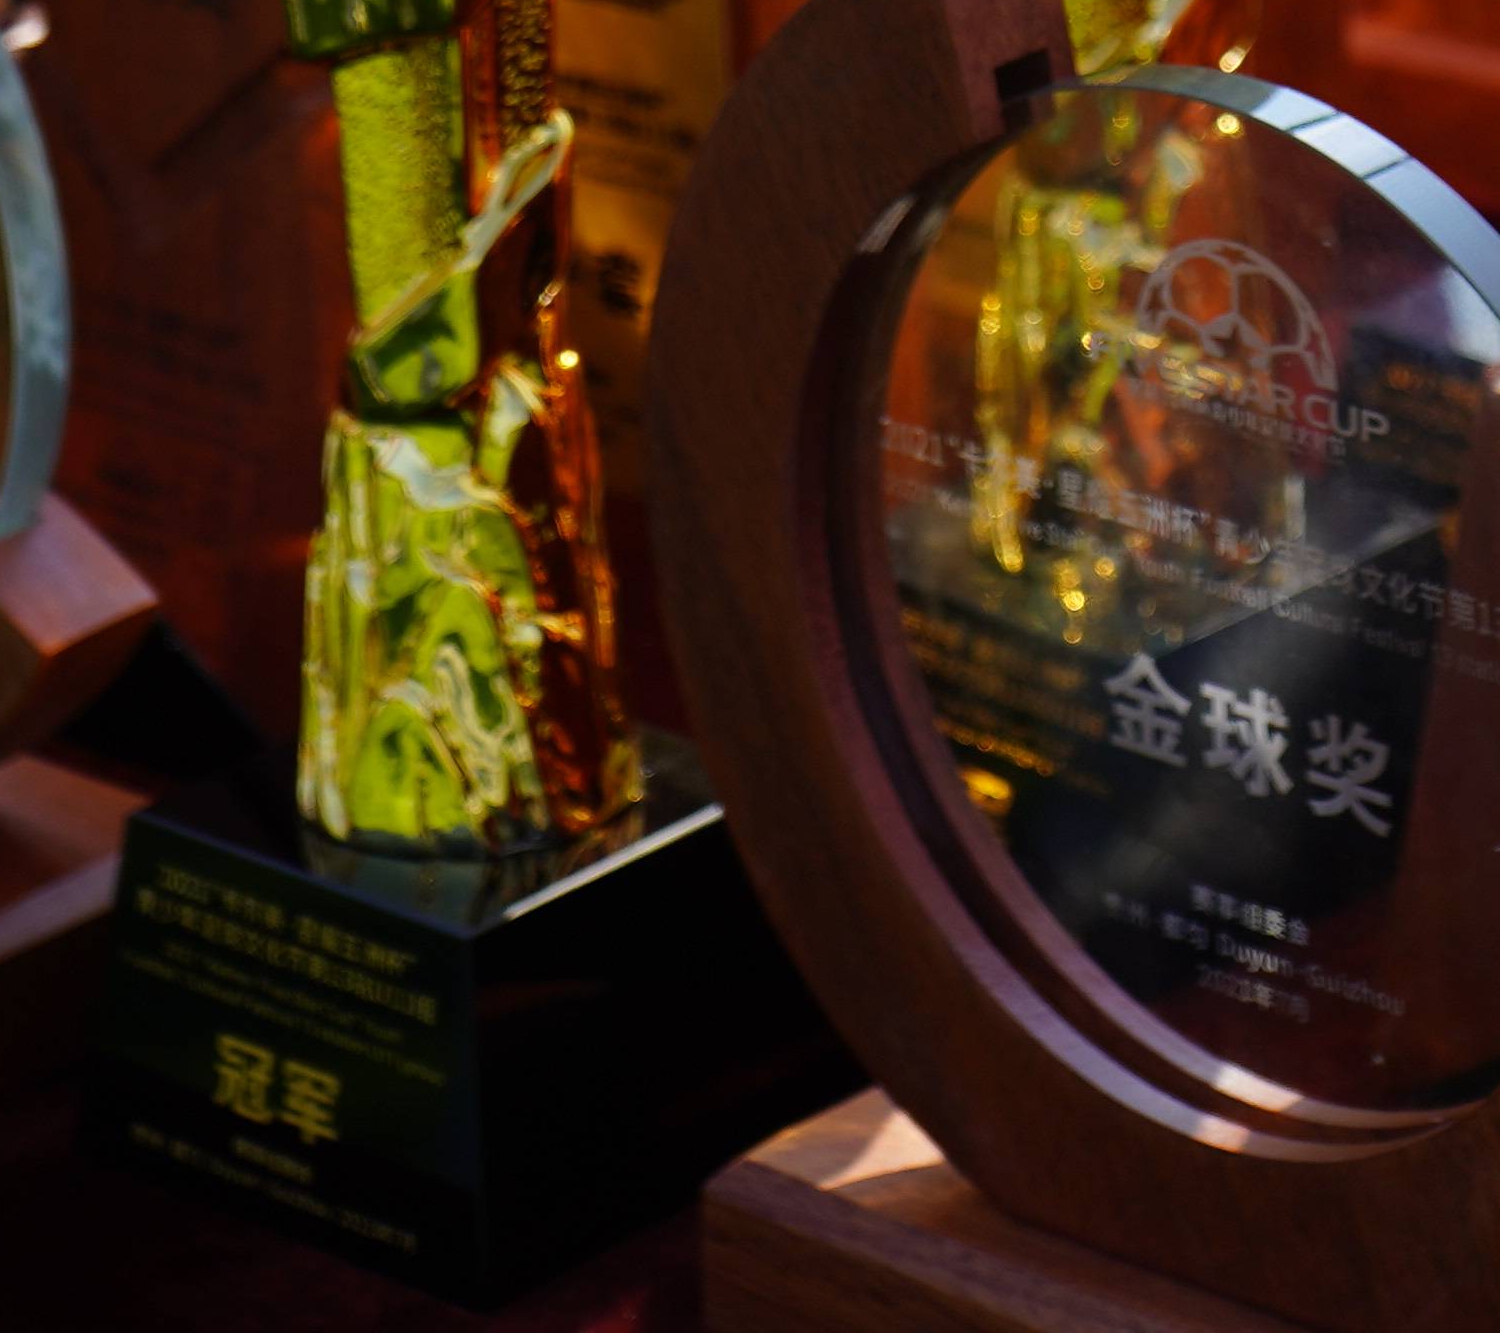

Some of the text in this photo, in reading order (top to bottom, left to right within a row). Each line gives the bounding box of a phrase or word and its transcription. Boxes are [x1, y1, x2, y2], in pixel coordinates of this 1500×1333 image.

[1303, 394, 1390, 442] CUP
[1106, 652, 1393, 836] 金球奖
[213, 1033, 340, 1144] 冠军
